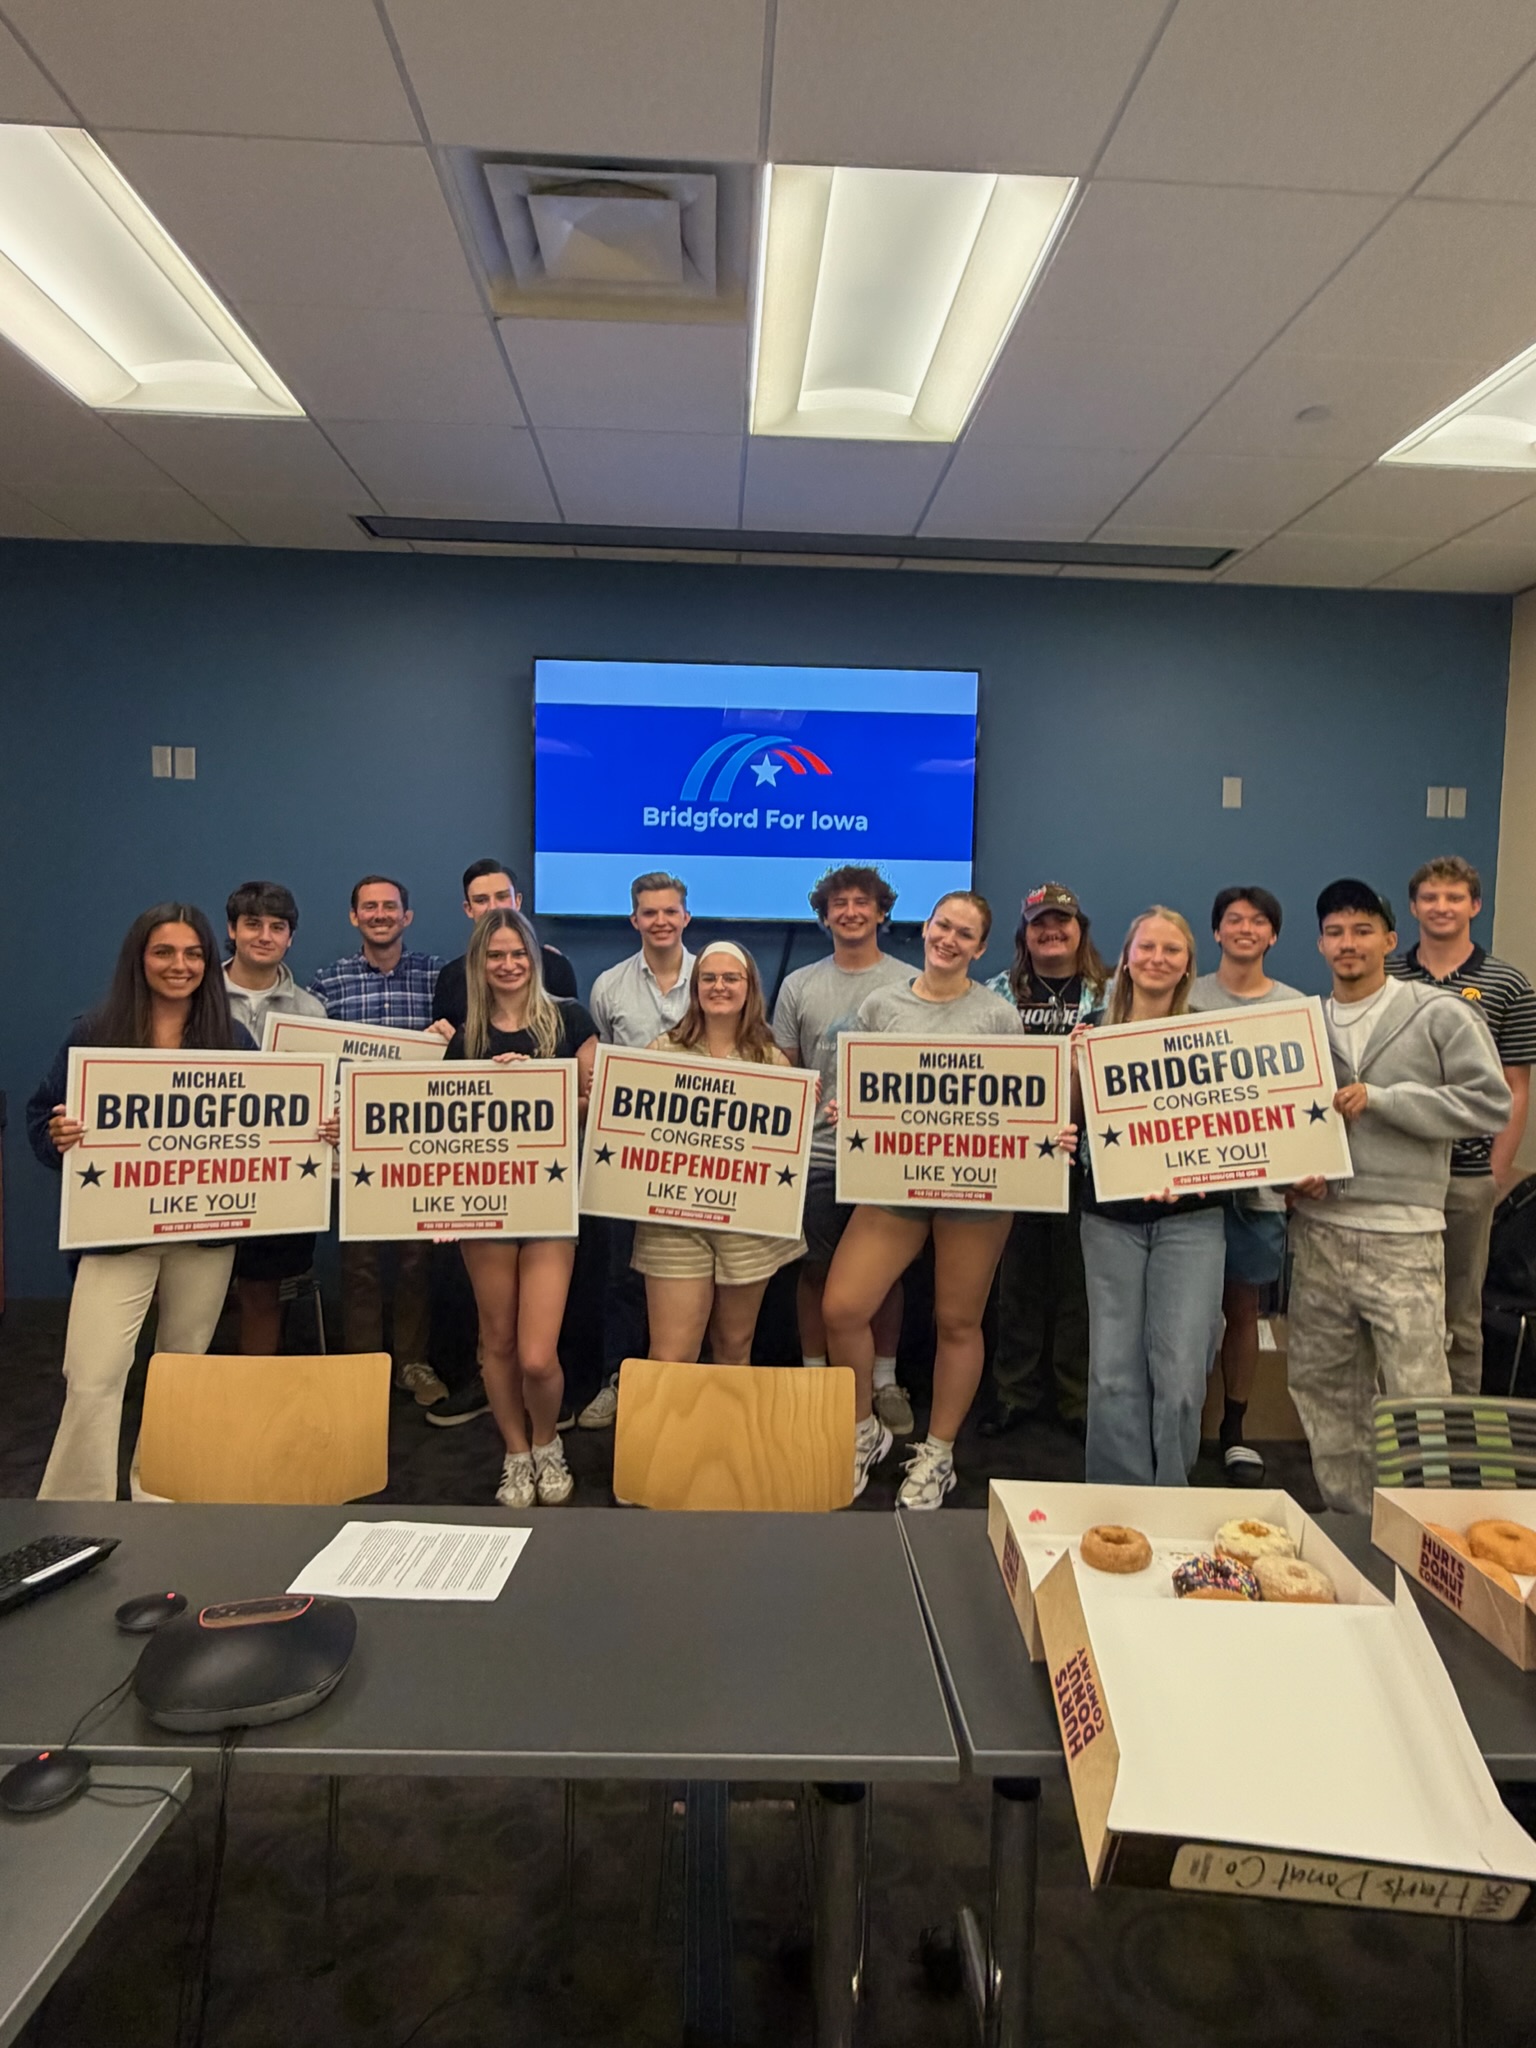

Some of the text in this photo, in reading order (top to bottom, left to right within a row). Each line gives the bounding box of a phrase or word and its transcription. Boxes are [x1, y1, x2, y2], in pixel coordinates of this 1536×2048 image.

[643, 806, 868, 833] Bridgford For Iowa
[342, 1039, 402, 1060] MICHAEL
[1163, 1028, 1233, 1052] MICHAEL
[919, 1052, 984, 1069] MICHAEL
[1104, 1040, 1305, 1097] BRIDGFORD
[172, 1071, 246, 1089] MICHAEL
[428, 1080, 493, 1097] MICHAEL
[674, 1073, 737, 1096] MICHAEL
[860, 1072, 1046, 1107] BRIDGFORD
[97, 1093, 310, 1129] BRIDGFORD
[612, 1085, 792, 1138] BRIDGFORD
[1153, 1084, 1259, 1112] CONGRESS
[365, 1099, 555, 1134] BRIDGFORD
[901, 1109, 1000, 1126] CONGRESS
[1128, 1103, 1296, 1147] INDEPENDENT
[148, 1134, 261, 1151] CONGRESS
[409, 1138, 509, 1155] CONGRESS
[650, 1127, 745, 1152] CONGRESS
[874, 1131, 1030, 1160] INDEPENDENT
[620, 1145, 772, 1186] INDEPENDENT
[1165, 1142, 1268, 1169] LIKE YOU!
[113, 1156, 292, 1188] INDEPENDENT
[381, 1160, 539, 1188] INDEPENDENT
[904, 1164, 997, 1184] LIKE YOU!
[150, 1192, 257, 1214] LIKE YOU!
[413, 1195, 508, 1213] LIKE YOU!
[647, 1181, 737, 1206] LIKE YOU!
[1422, 1532, 1465, 1580] HURTS
[1420, 1553, 1465, 1596] DONUT
[1066, 1655, 1096, 1748] DONUT
[1076, 1647, 1105, 1734] COMPANY
[1055, 1667, 1084, 1761] HURTS
